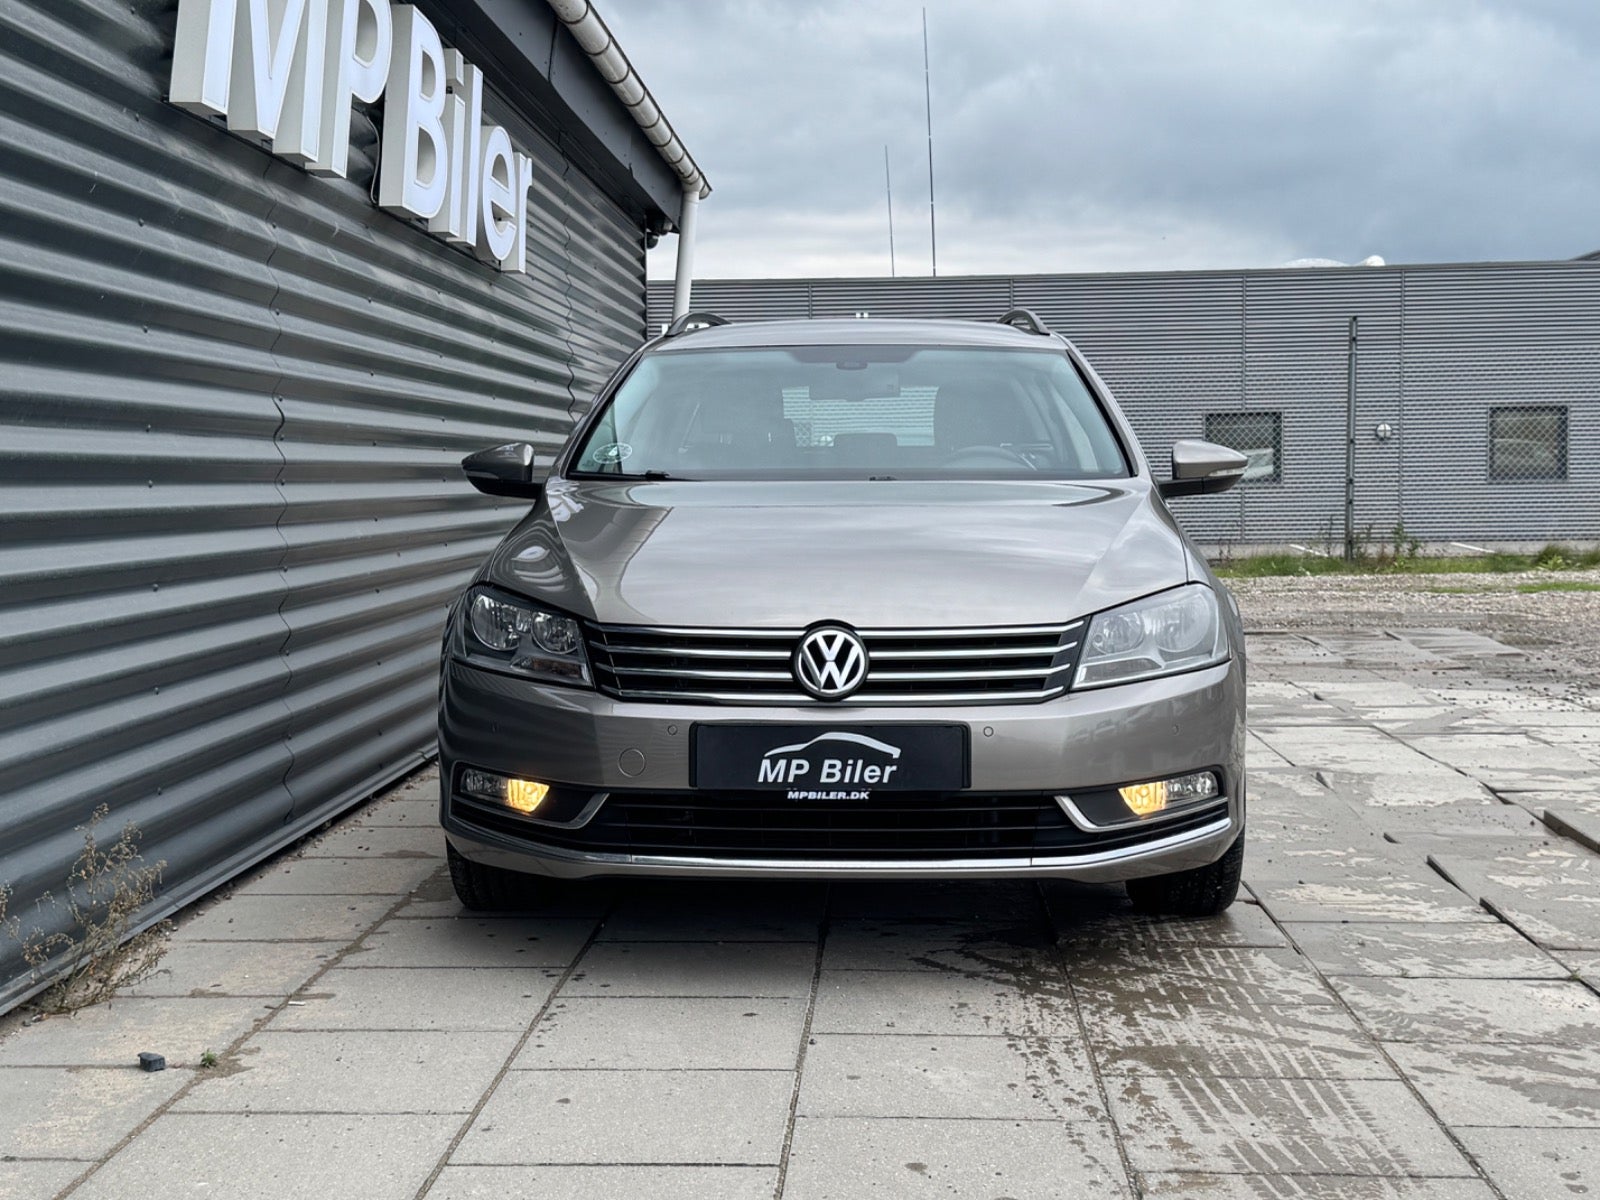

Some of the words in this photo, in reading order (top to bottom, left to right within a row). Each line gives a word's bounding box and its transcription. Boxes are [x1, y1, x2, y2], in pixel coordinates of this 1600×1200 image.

[379, 4, 533, 274] Biler
[799, 630, 866, 694] VW
[757, 758, 810, 783] MP
[819, 758, 898, 783] Biler
[786, 791, 870, 800] MPBILER.DK
